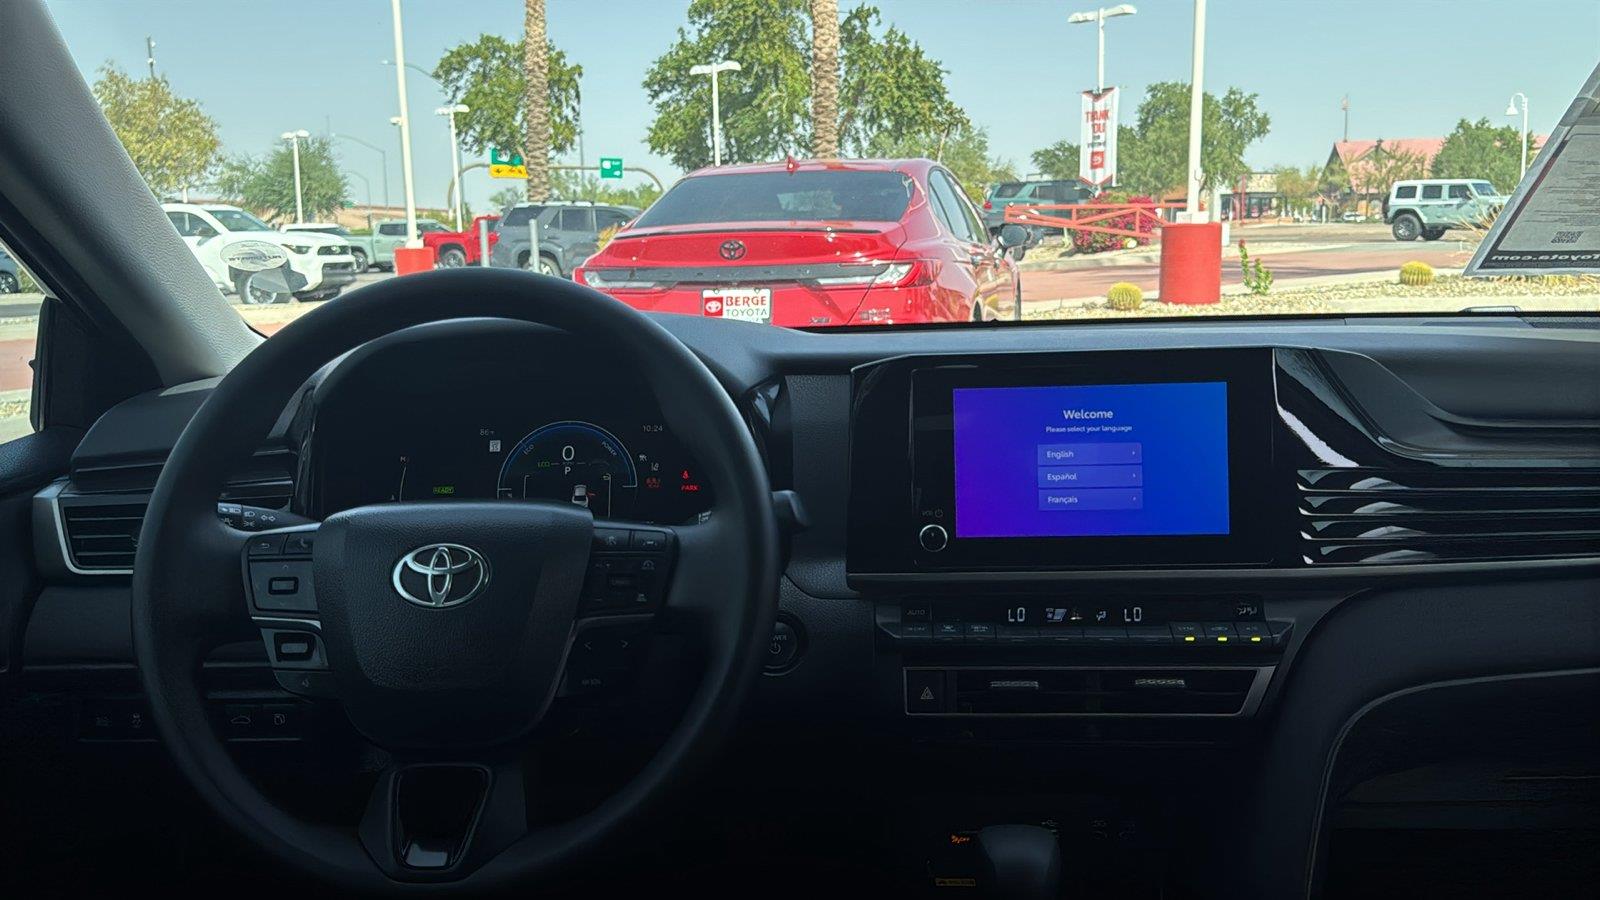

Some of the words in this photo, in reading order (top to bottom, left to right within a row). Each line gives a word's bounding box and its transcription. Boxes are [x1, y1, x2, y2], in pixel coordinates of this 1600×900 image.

[725, 296, 767, 307] BERGE
[726, 308, 768, 317] TOYOTA
[1063, 409, 1114, 420] Welcome
[642, 425, 663, 433] 10:24
[1067, 425, 1086, 433] select
[1086, 426, 1101, 434] your
[1101, 425, 1133, 433] language
[562, 445, 575, 461] 0
[1046, 451, 1074, 460] English
[565, 466, 572, 475] P
[1047, 473, 1078, 482] Español
[1047, 496, 1079, 504] Français
